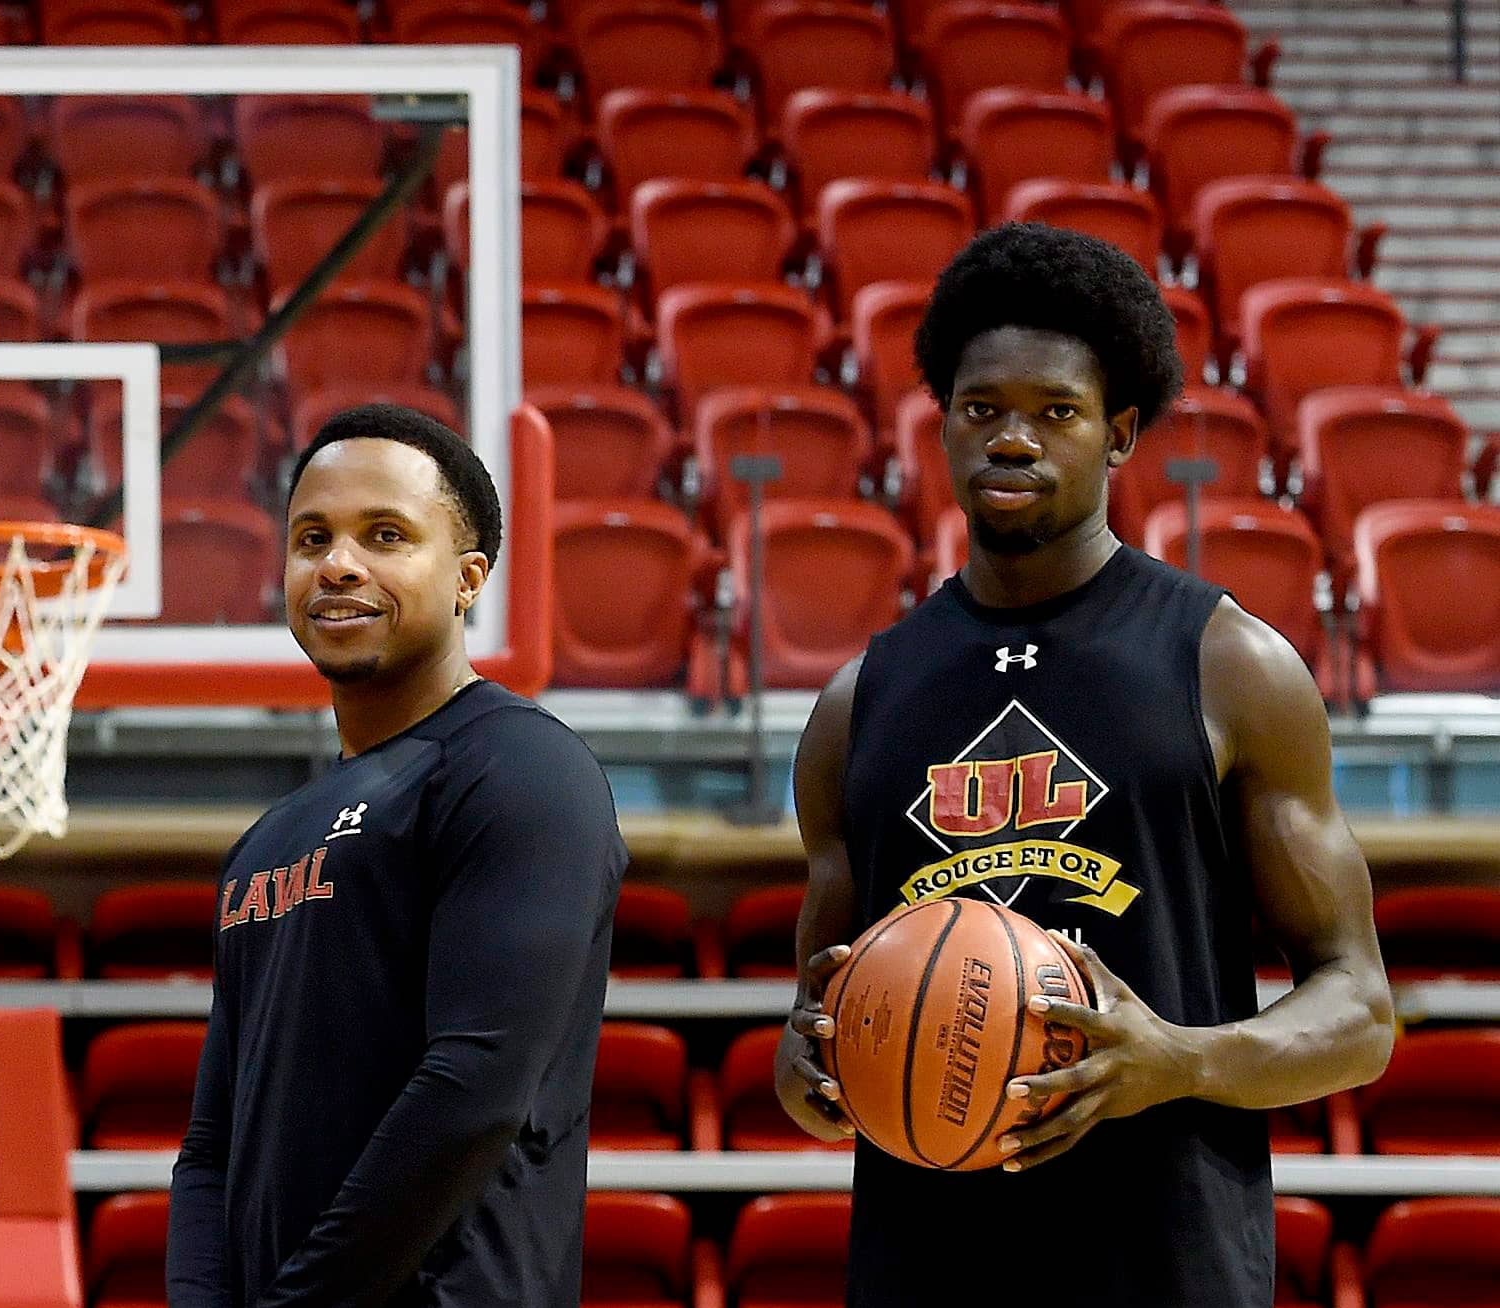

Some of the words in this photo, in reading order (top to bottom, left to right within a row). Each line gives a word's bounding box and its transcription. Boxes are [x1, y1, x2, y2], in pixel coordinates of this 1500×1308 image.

[927, 750, 1088, 837] UL
[911, 851, 1013, 899] ROUGE
[1019, 847, 1055, 868] ET
[1059, 852, 1103, 883] OR
[943, 957, 993, 1128] EVOLUTION
